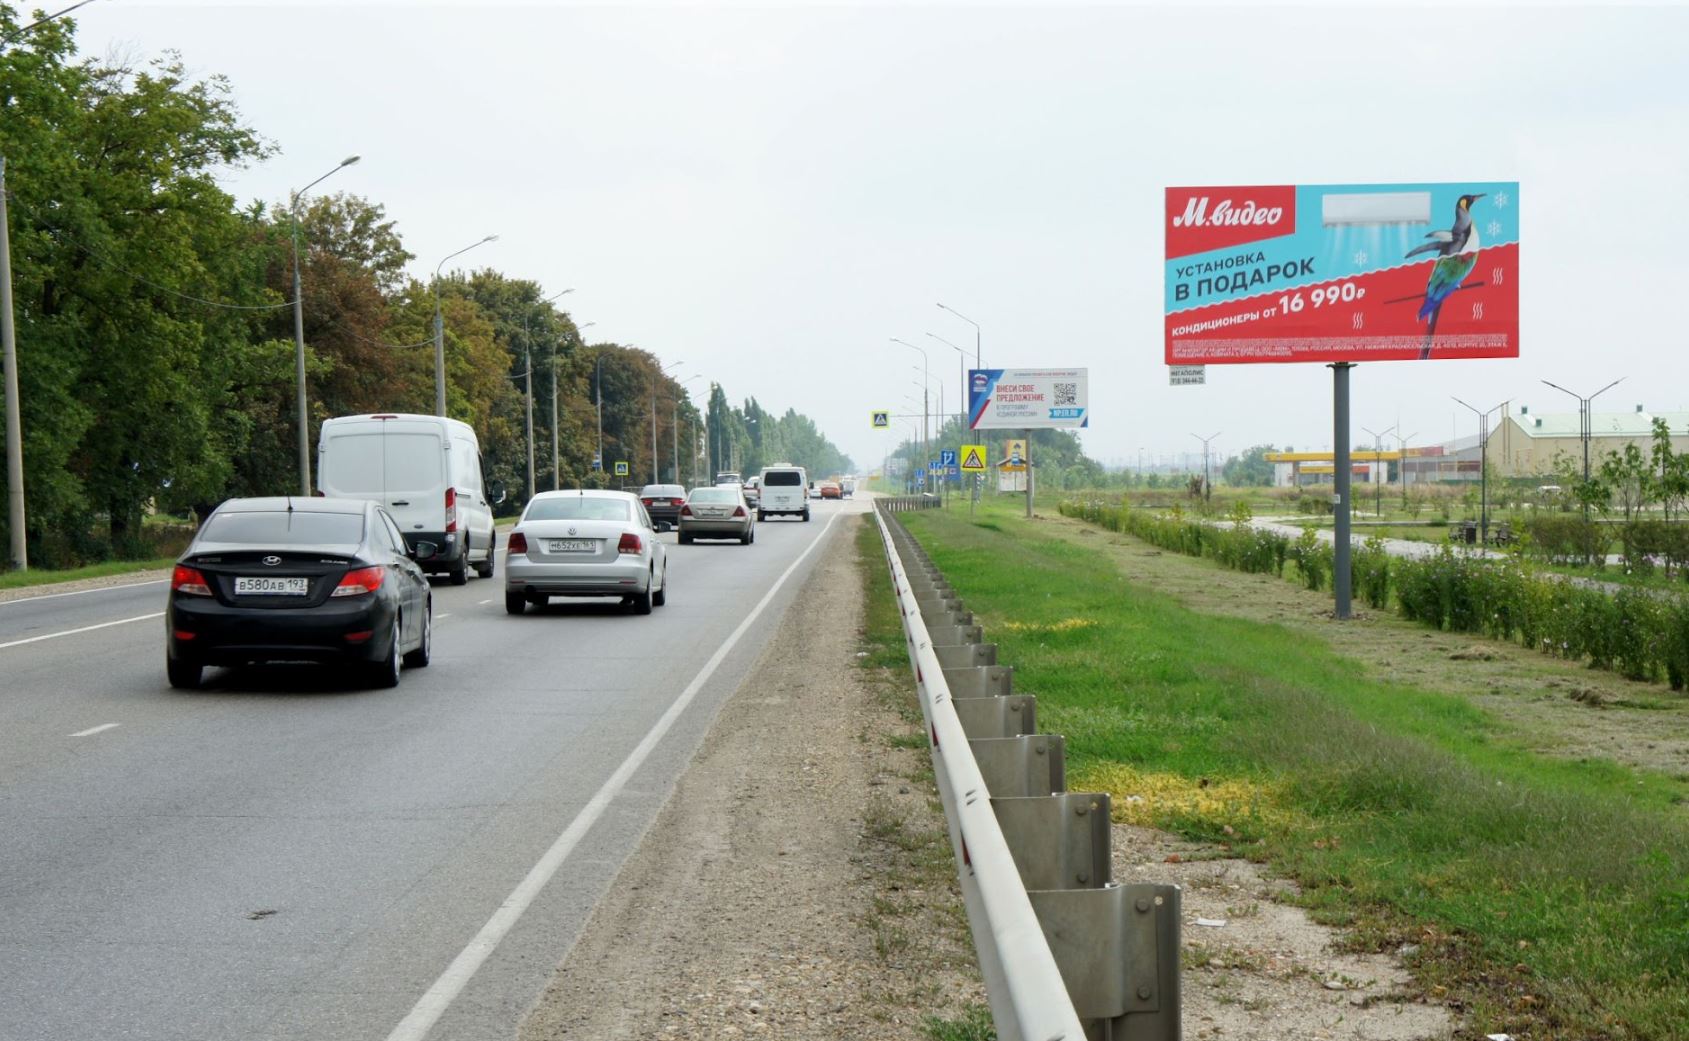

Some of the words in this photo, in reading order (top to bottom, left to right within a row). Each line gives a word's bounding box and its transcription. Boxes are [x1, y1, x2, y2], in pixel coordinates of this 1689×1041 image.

[1173, 197, 1283, 228] М.видео
[1176, 251, 1265, 279] УСТАНОВКА
[1175, 283, 1189, 302] В
[1197, 256, 1315, 297] ПОДАРОК
[1172, 311, 1260, 337] КОНДИЦИОНЕРЫ
[996, 384, 1018, 393] ВНЕСИ
[1018, 384, 1035, 393] СВОЕ
[996, 393, 1045, 403] ПРЕДЛОЖЕНИЕ
